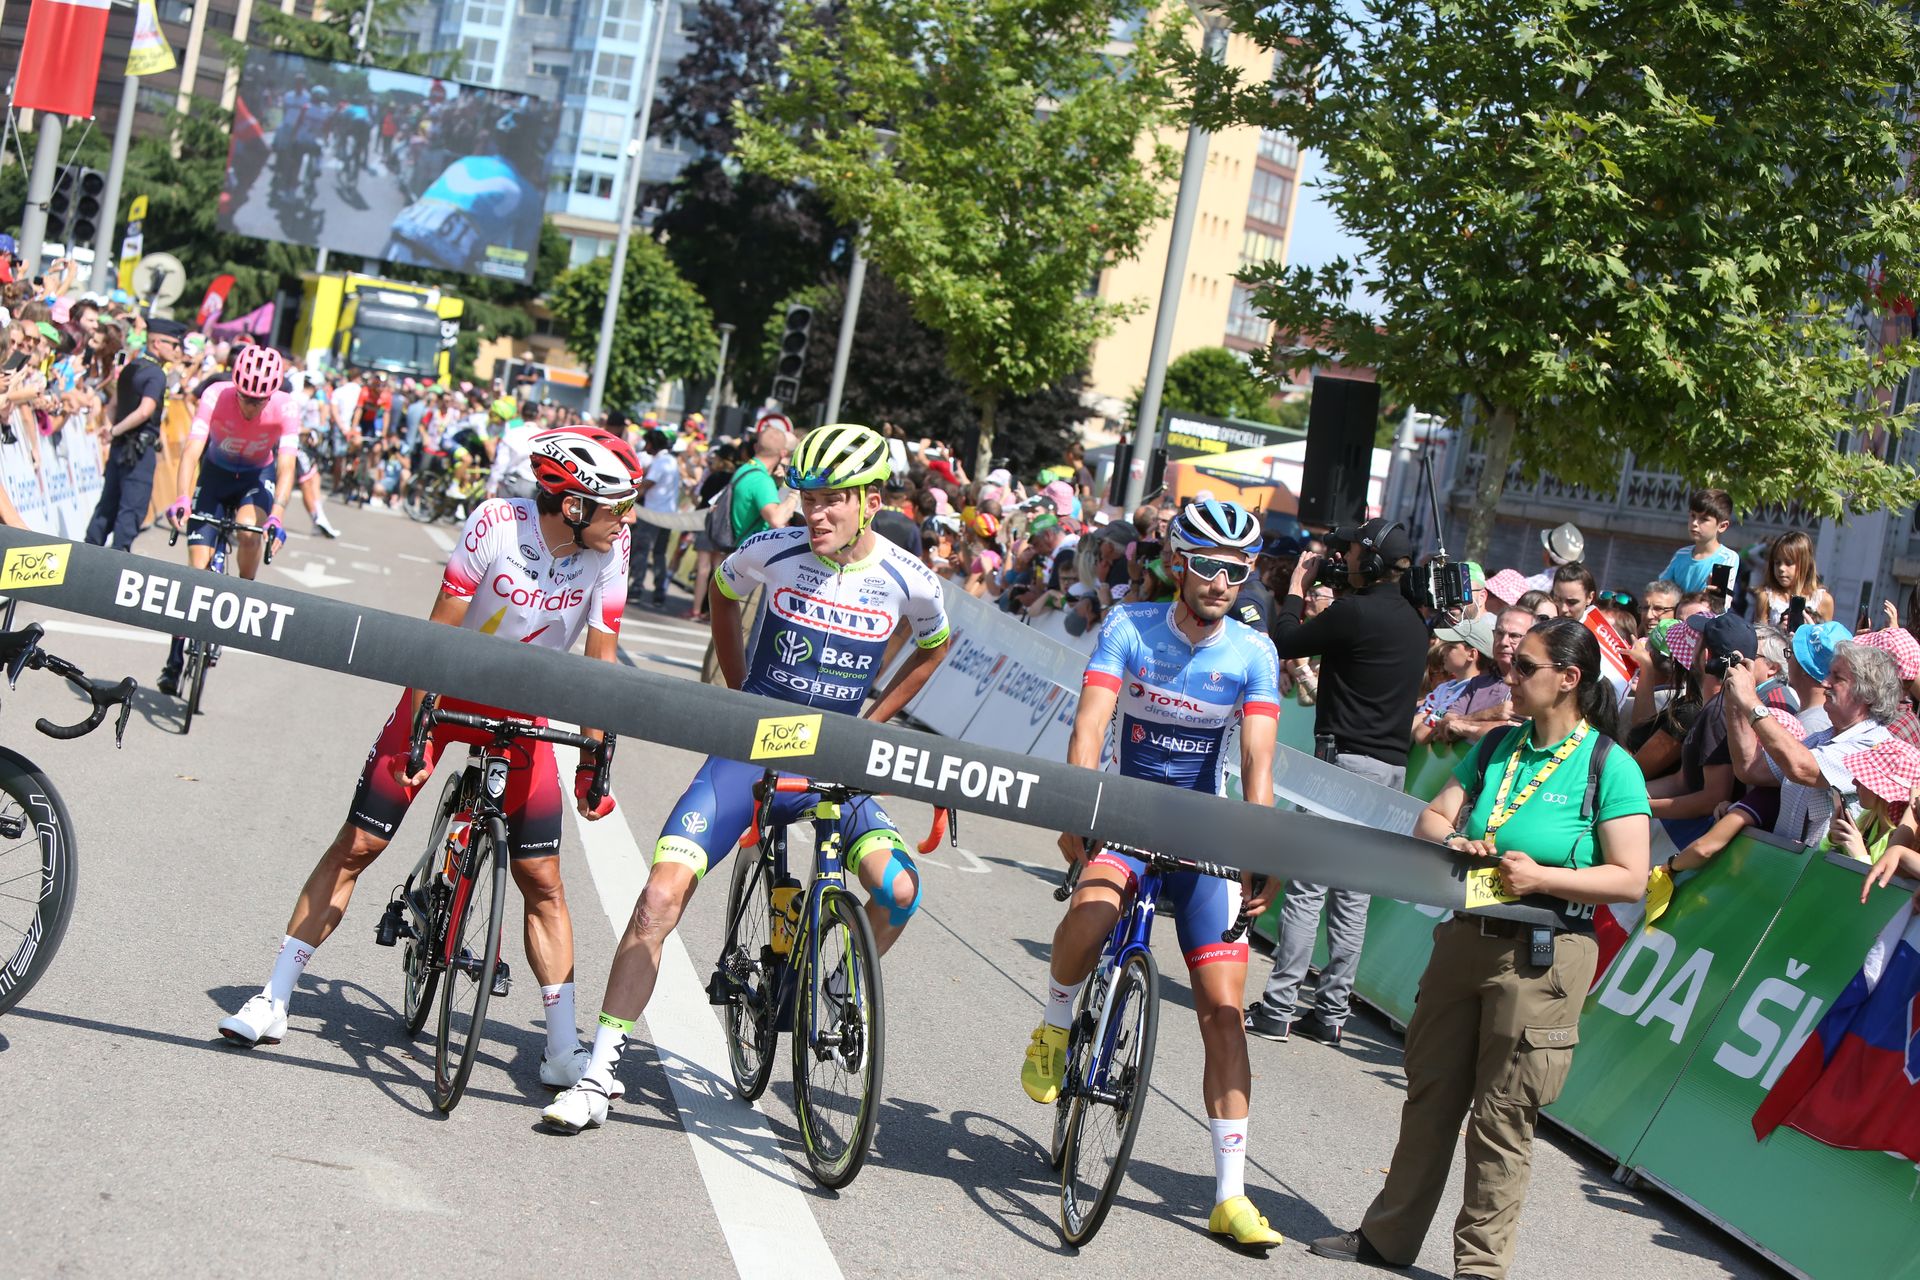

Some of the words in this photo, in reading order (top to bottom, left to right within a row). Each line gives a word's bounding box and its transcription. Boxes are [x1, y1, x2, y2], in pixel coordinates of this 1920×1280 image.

[9, 565, 59, 581] france
[493, 574, 584, 611] Cofidis
[114, 568, 294, 641] BELFORT
[789, 596, 880, 630] WANTY
[821, 647, 873, 670] B&R
[772, 670, 861, 699] GOBERT
[1202, 683, 1225, 693] Nalini
[1148, 691, 1204, 713] TOTAL
[761, 735, 811, 752] france
[865, 739, 1040, 809] BELFORT
[355, 811, 385, 828] KUOTA
[520, 841, 553, 849] KUOTA
[1472, 883, 1505, 900] franc
[1597, 925, 1714, 1045] DA
